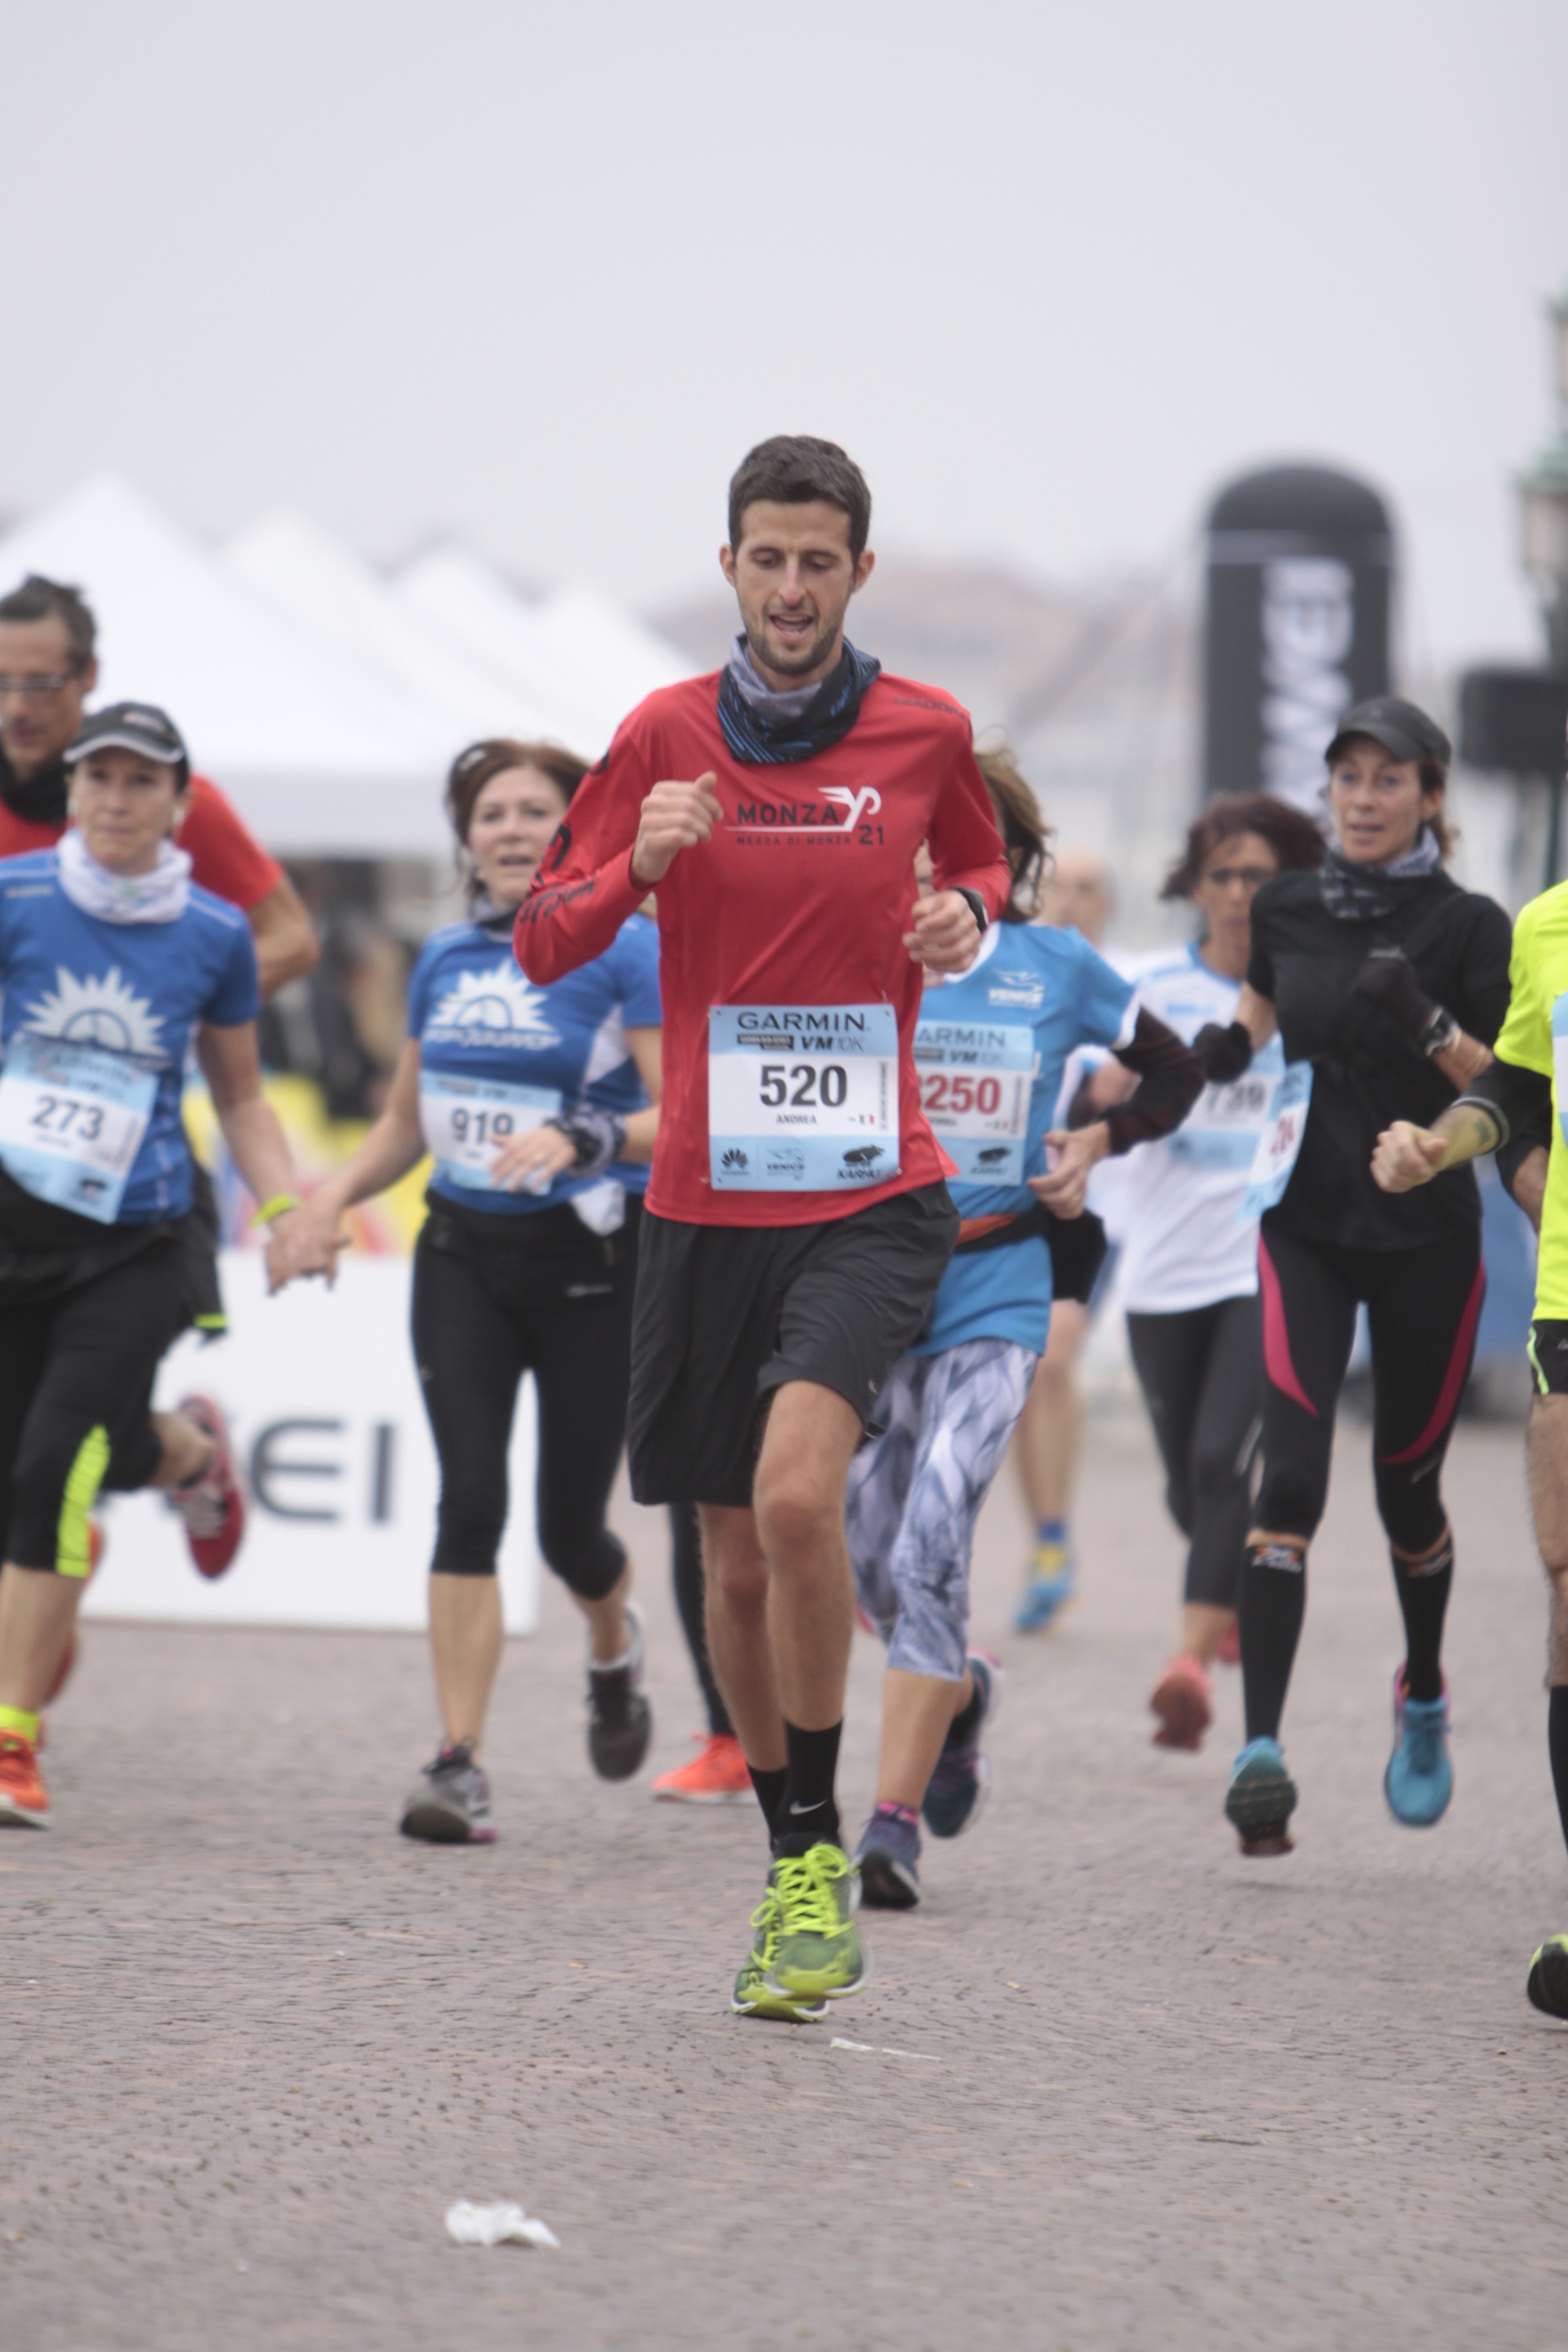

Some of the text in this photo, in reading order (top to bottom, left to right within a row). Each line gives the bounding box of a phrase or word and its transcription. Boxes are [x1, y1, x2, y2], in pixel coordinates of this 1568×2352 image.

[738, 804, 838, 825] MONZA
[806, 836, 852, 845] MONZA
[859, 825, 884, 845] 21
[738, 1012, 865, 1031] GARMIN
[917, 1028, 1006, 1047] ARMIN
[760, 1065, 847, 1107] 520
[918, 1075, 1002, 1115] 250
[31, 1096, 105, 1141] 273
